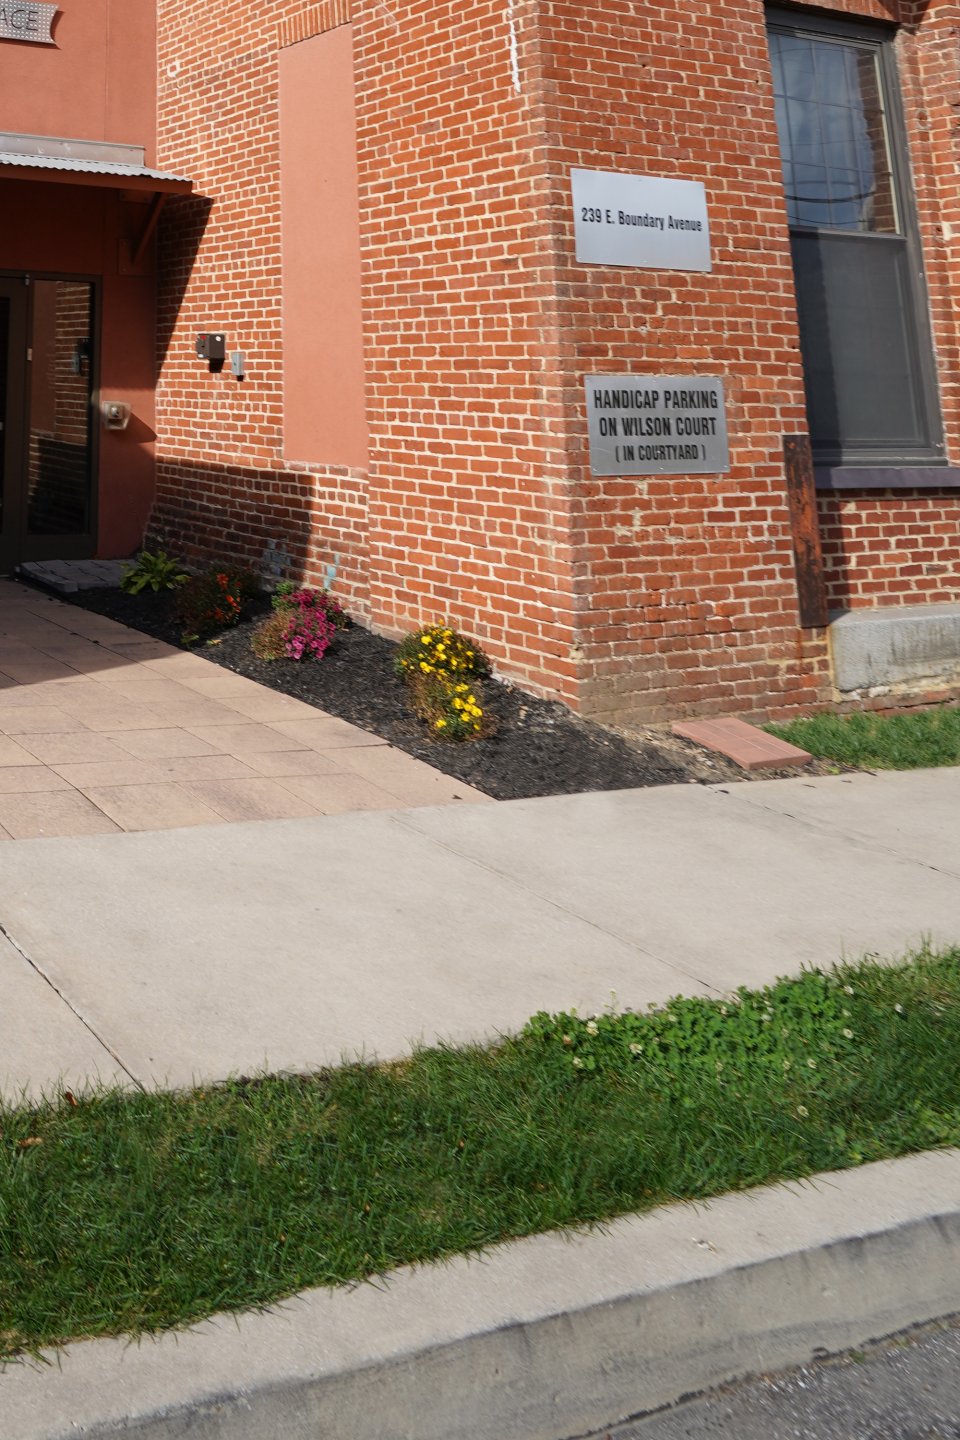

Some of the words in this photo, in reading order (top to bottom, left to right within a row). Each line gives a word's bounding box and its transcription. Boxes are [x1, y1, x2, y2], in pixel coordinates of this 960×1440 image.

[581, 207, 602, 223] 239
[605, 209, 615, 224] E.
[618, 210, 664, 231] Boundary
[668, 215, 702, 231] Avenue
[593, 390, 659, 409] HANDICAP
[663, 390, 718, 409] PARKING
[599, 417, 618, 436] ON
[621, 417, 672, 436] WILSON
[675, 417, 717, 436] COURT
